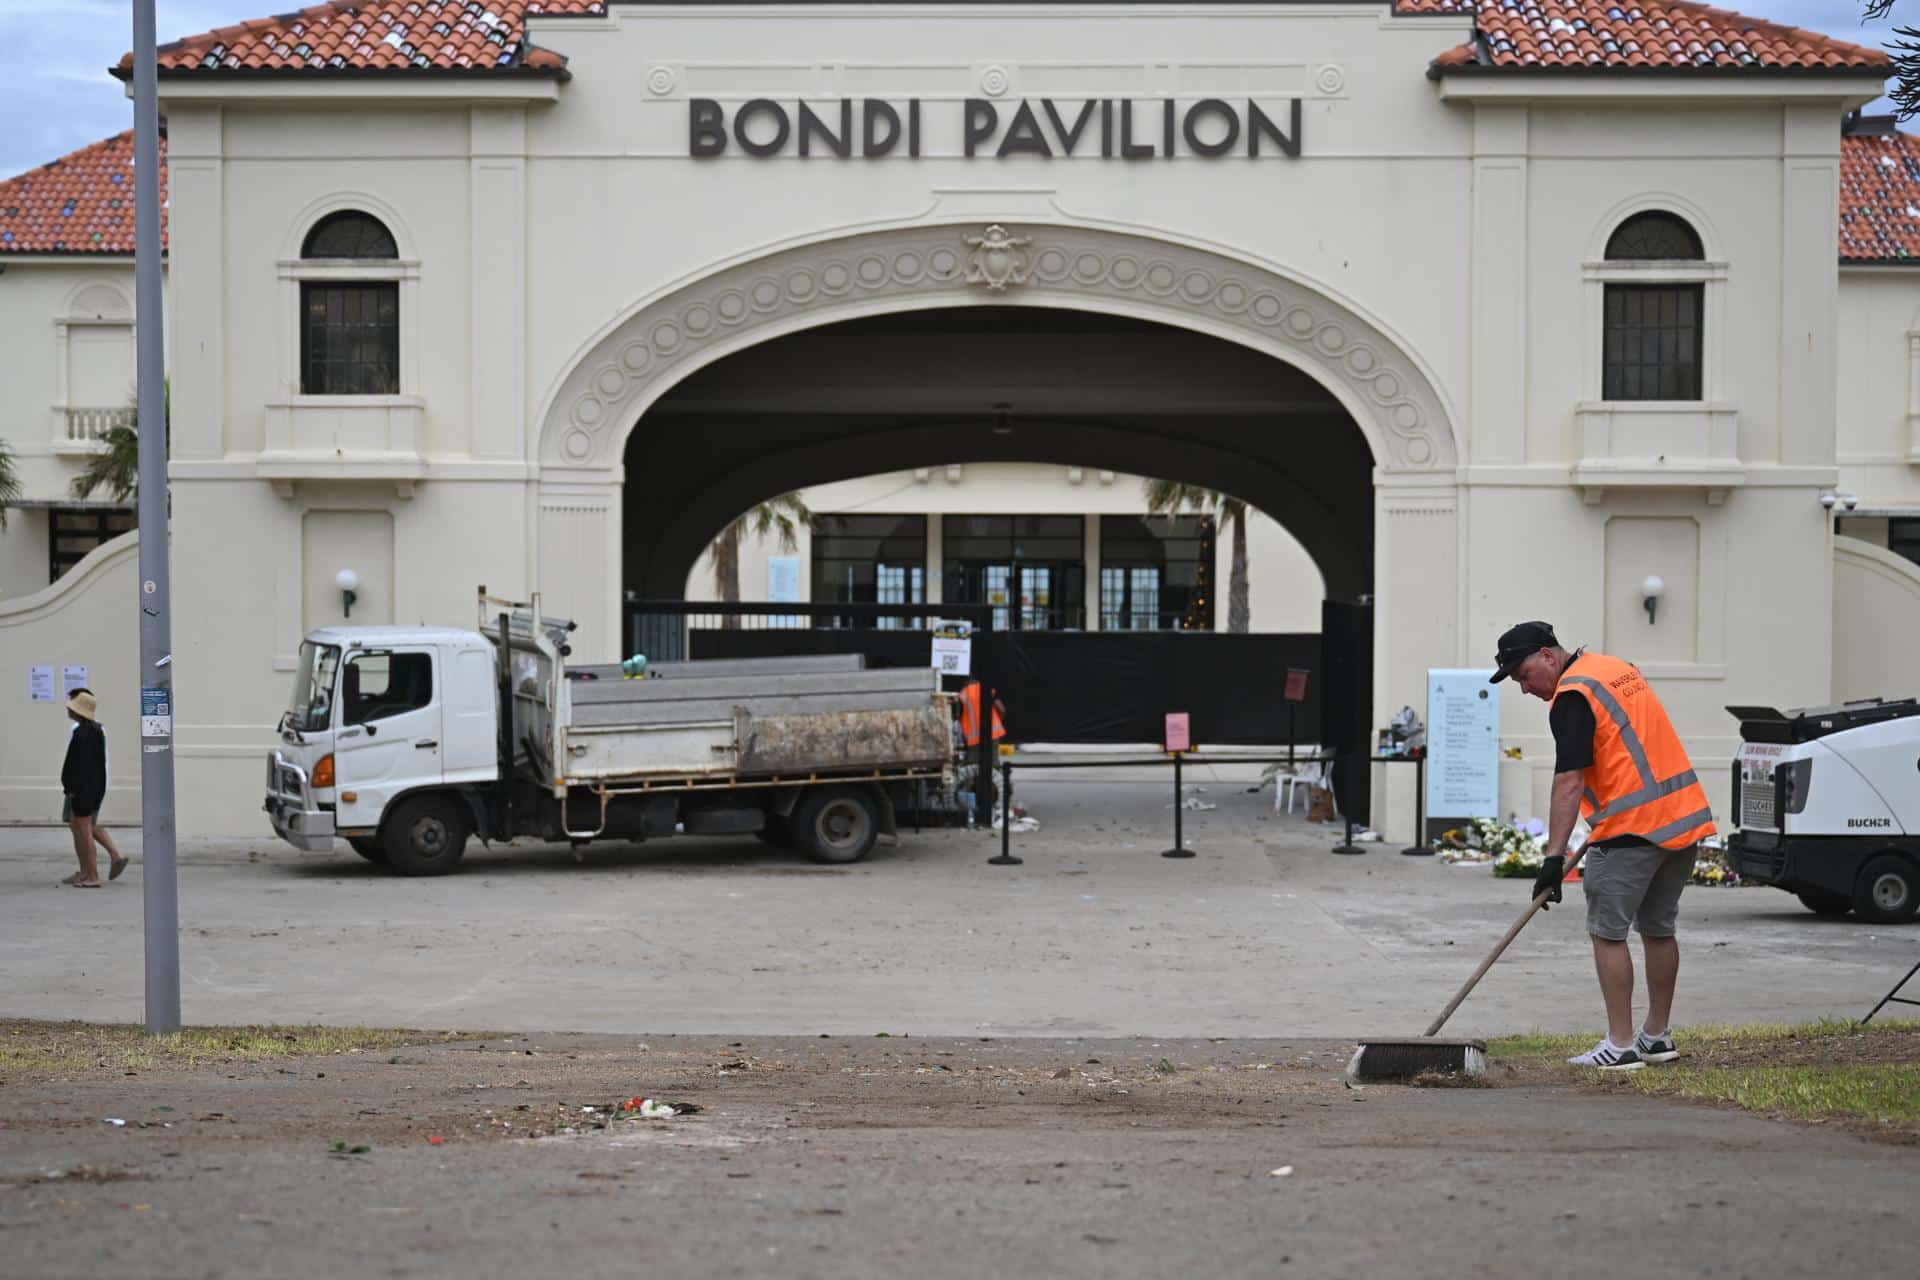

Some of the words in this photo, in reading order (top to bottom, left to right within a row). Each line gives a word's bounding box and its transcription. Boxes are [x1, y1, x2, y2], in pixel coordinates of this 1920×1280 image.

[689, 98, 920, 158] BONDI
[964, 98, 1302, 158] PAVILION
[1847, 818, 1891, 828] BUCHER
